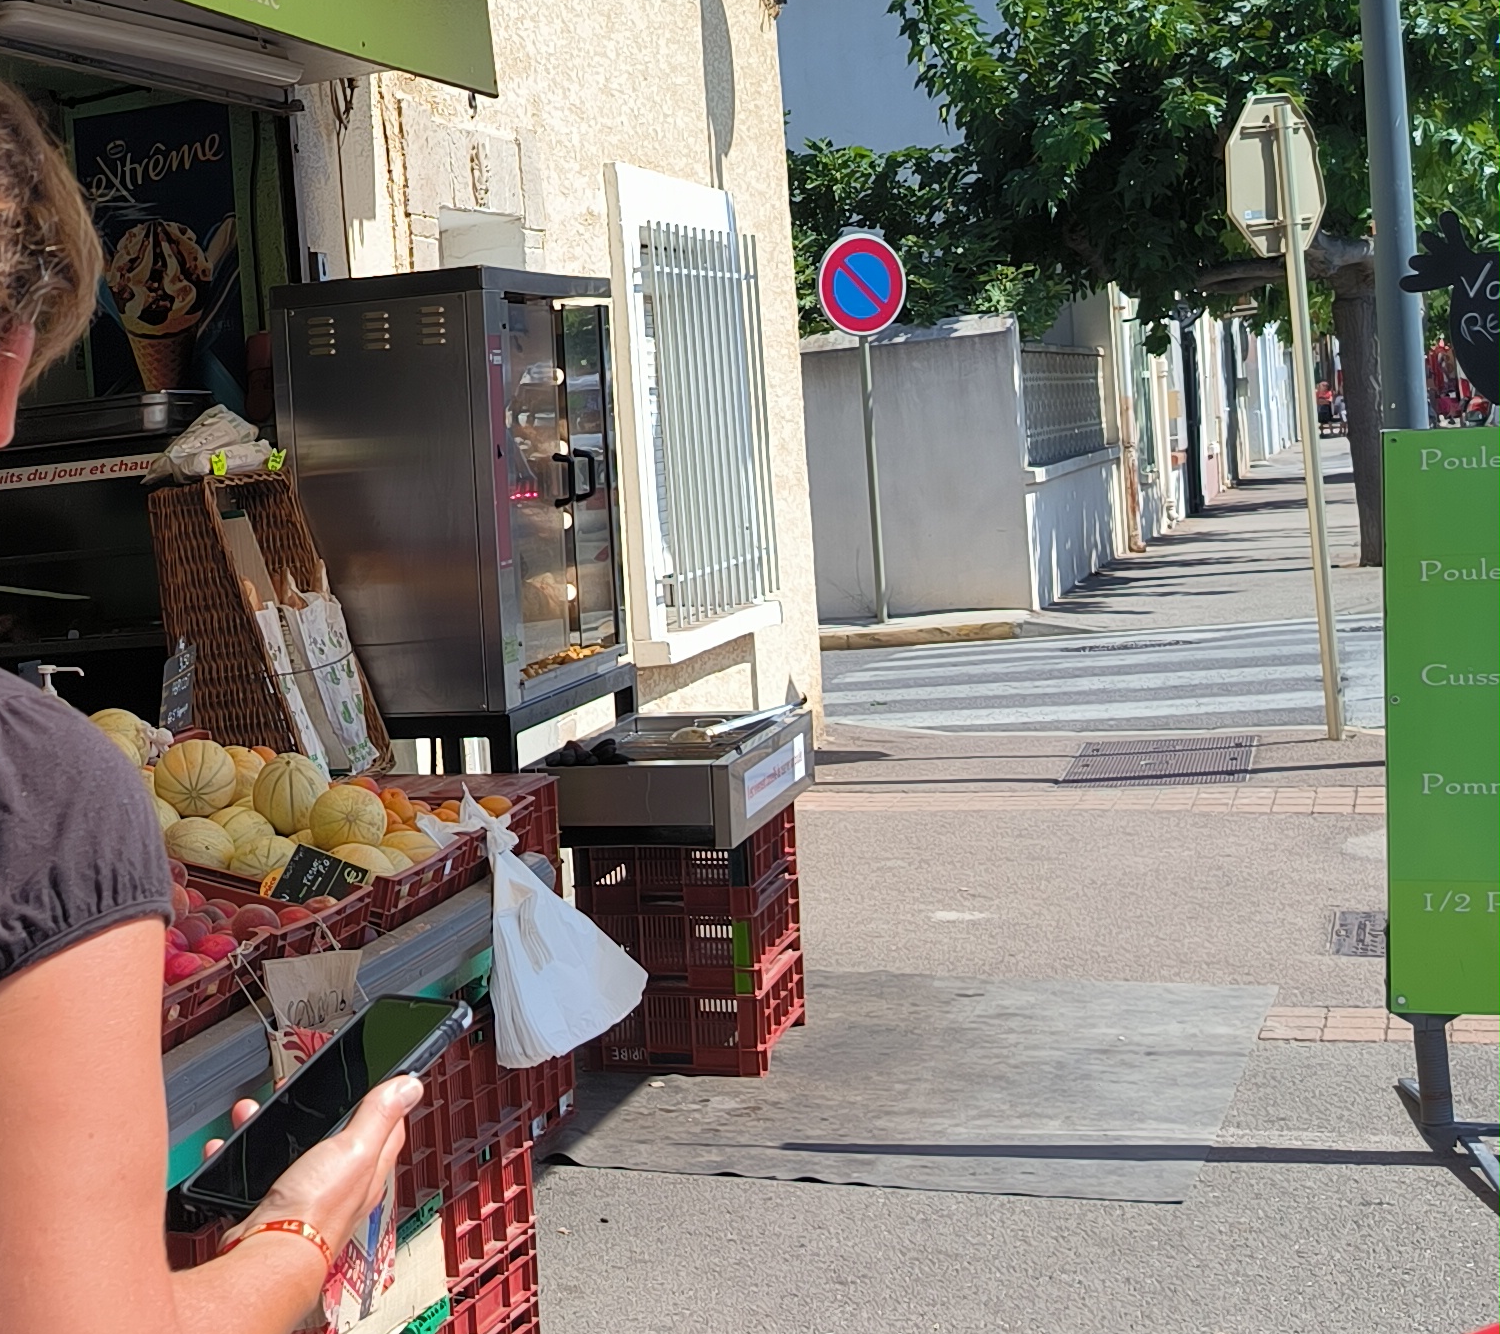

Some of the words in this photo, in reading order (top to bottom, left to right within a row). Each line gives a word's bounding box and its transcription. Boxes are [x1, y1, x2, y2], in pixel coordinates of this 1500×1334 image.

[27, 468, 47, 482] du
[49, 466, 85, 482] jour
[89, 462, 106, 474] et
[110, 459, 153, 473] chau
